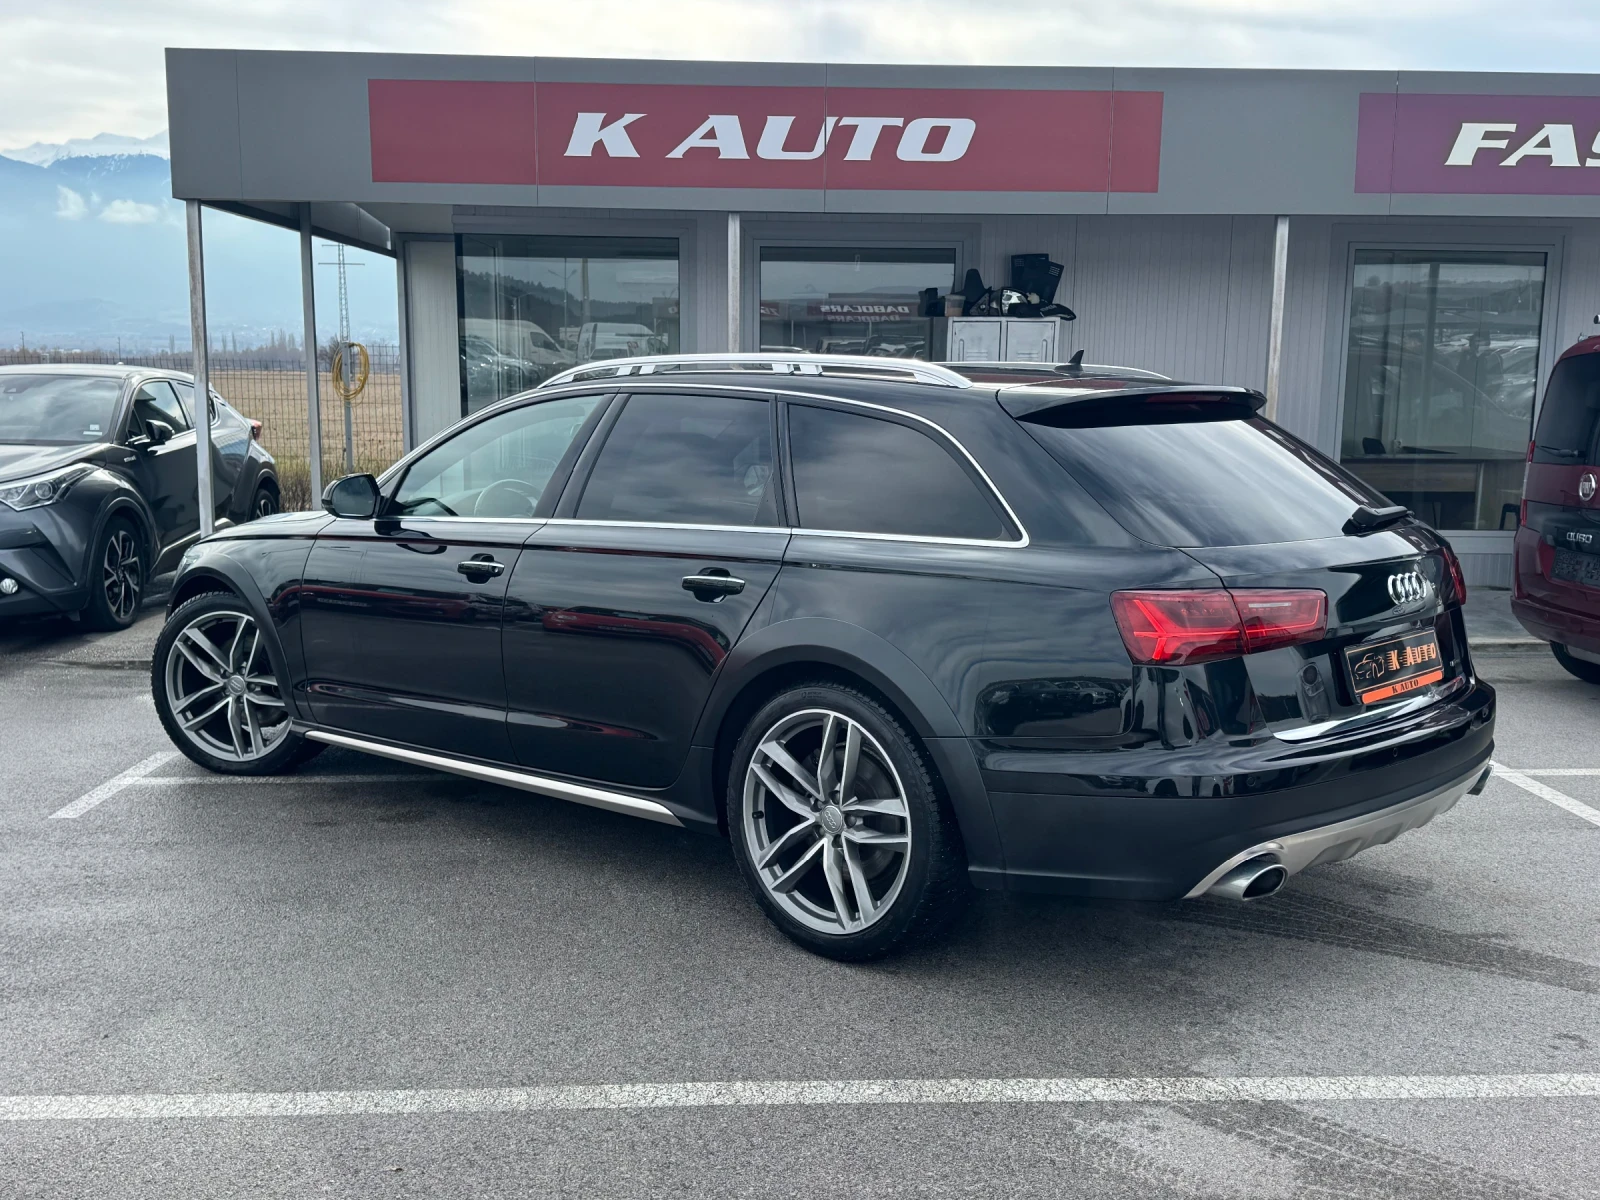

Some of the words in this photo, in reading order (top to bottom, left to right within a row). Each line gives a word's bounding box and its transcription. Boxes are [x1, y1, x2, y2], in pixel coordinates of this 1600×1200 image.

[563, 112, 648, 158] K
[665, 114, 977, 162] AUTO
[1392, 686, 1398, 694] K
[1400, 679, 1419, 691] AUTO
